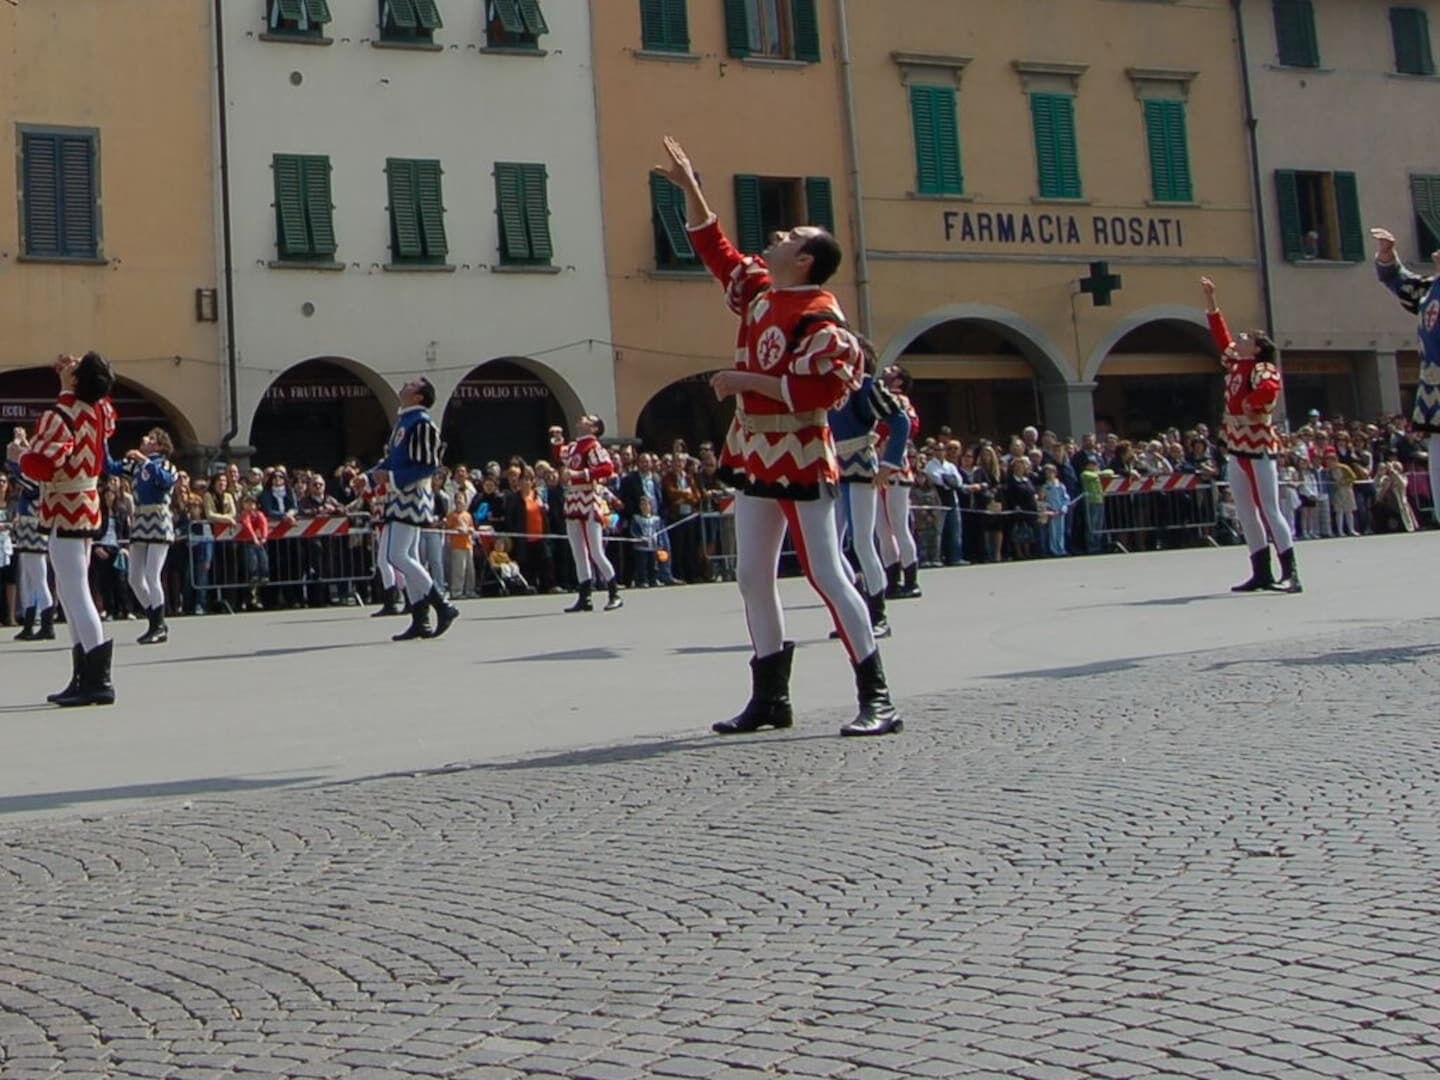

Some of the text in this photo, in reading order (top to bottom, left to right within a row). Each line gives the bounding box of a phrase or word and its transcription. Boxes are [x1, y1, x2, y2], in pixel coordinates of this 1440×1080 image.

[943, 211, 1183, 247] FARMACIA ROSATI
[482, 385, 510, 399] OLIO
[522, 386, 549, 399] VINO
